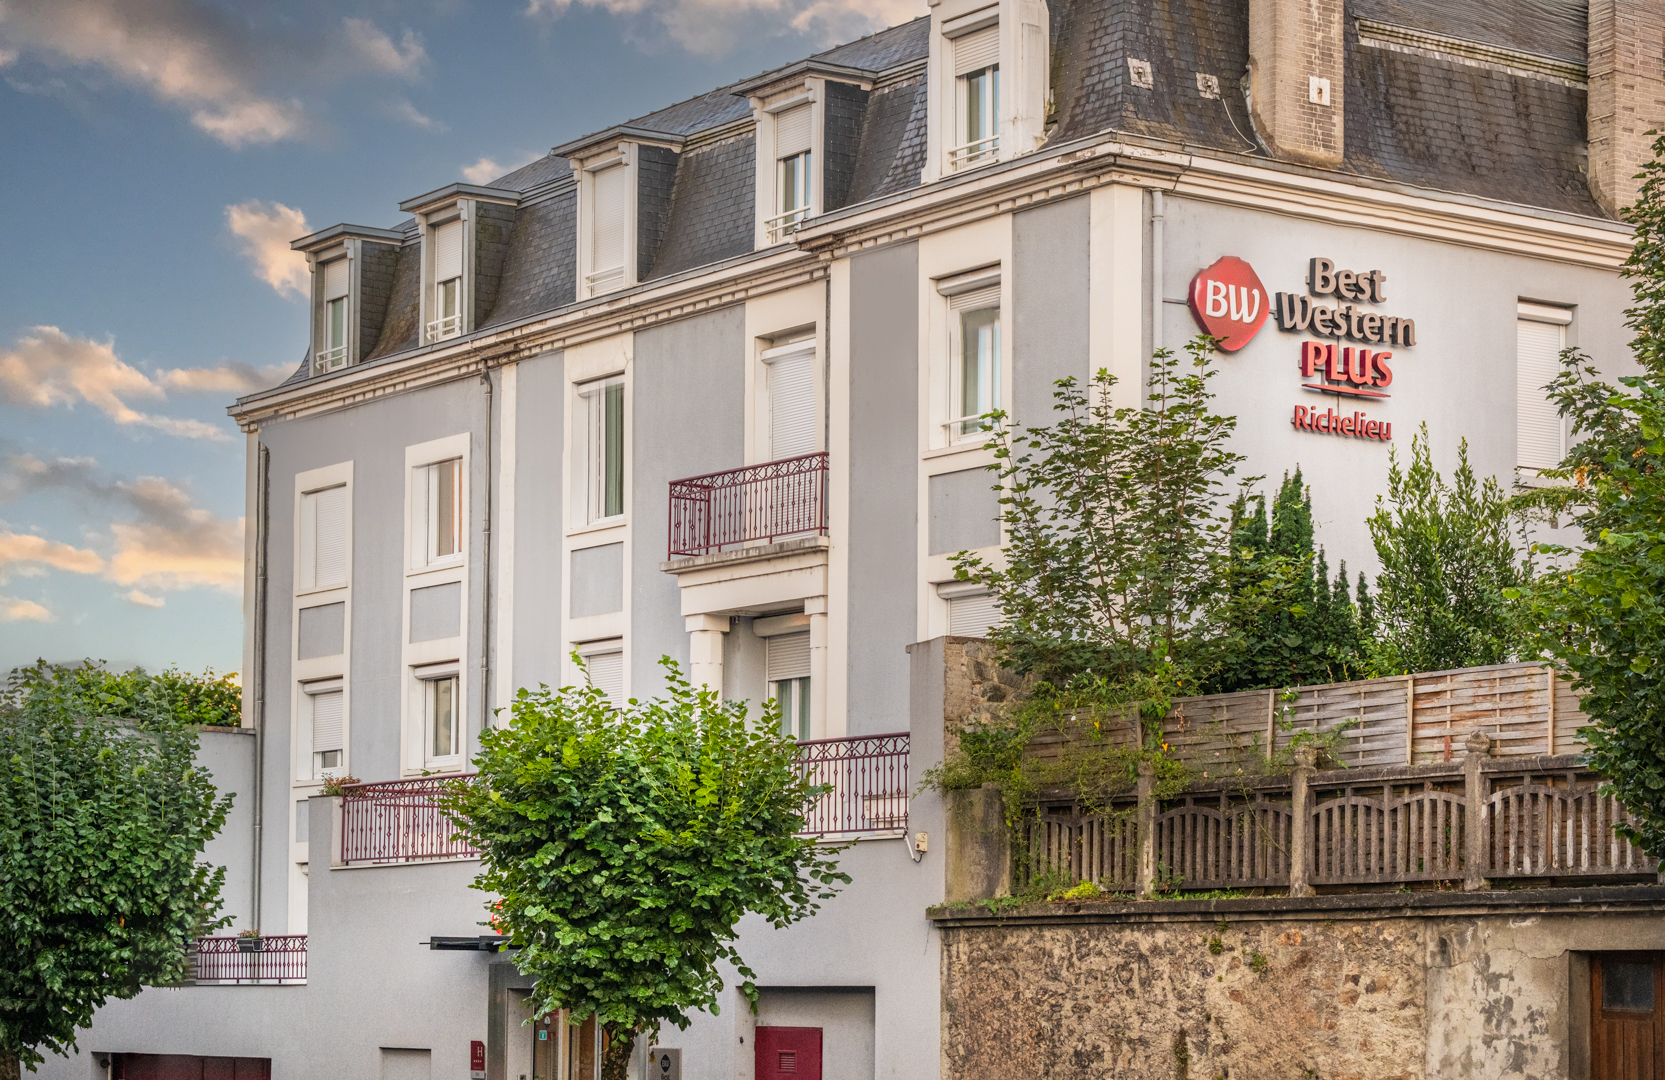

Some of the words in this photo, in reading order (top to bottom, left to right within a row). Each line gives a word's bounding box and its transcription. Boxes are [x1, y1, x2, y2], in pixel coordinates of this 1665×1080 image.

[1206, 279, 1260, 324] BW
[1310, 257, 1387, 304] Best
[1276, 291, 1417, 347] Western
[1302, 340, 1393, 388] PLUS
[1293, 404, 1392, 441] Richelieu
[477, 1046, 483, 1057] H
